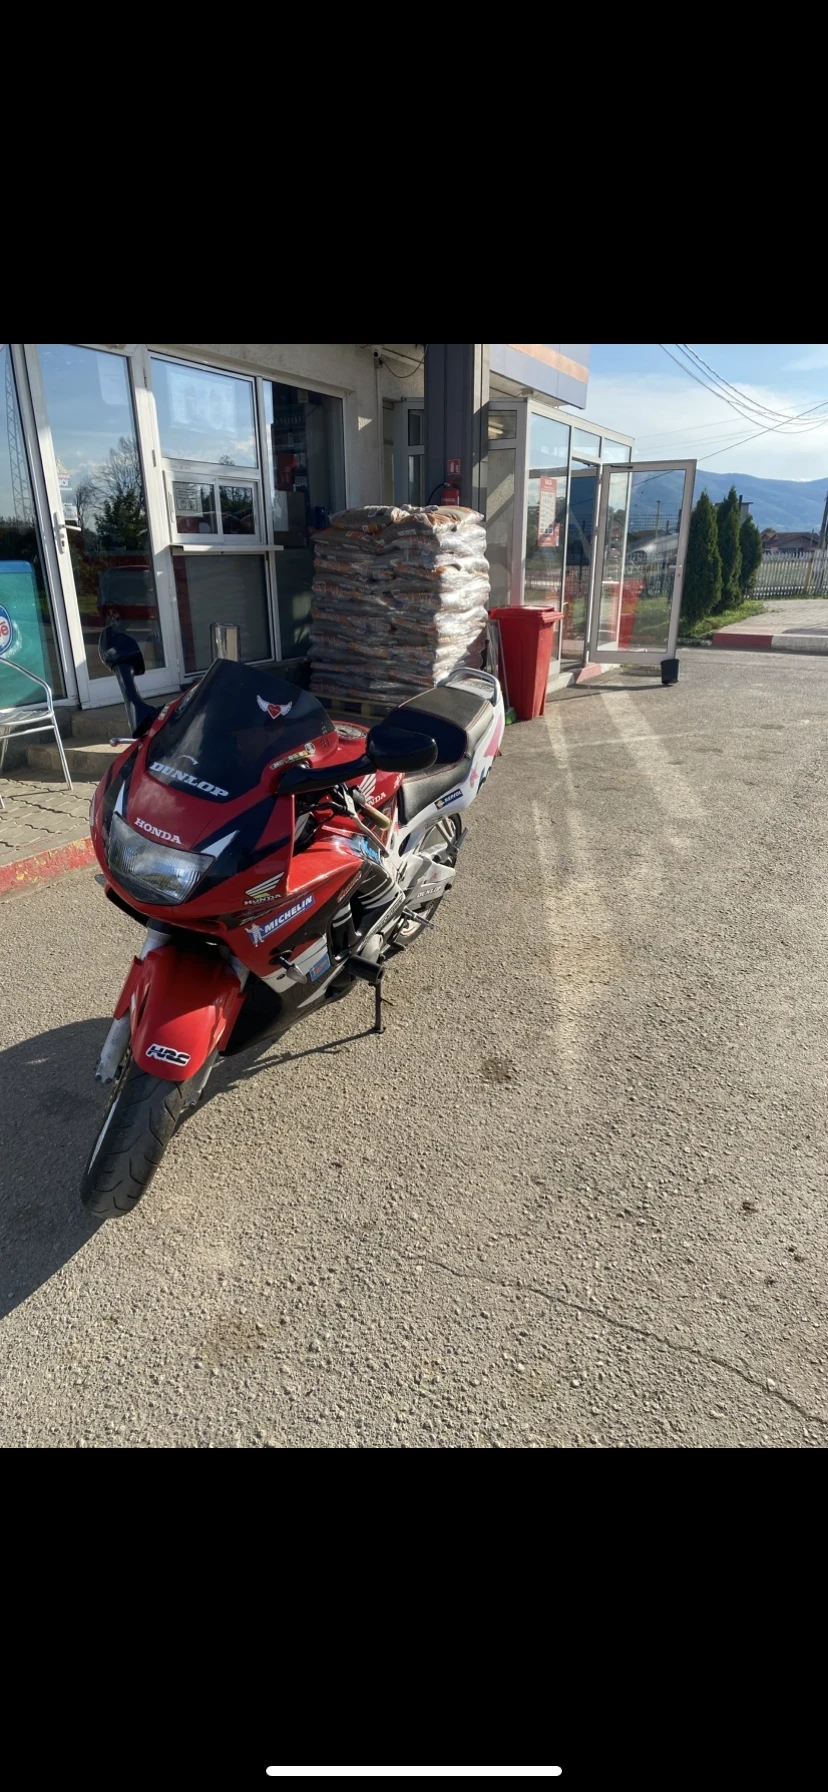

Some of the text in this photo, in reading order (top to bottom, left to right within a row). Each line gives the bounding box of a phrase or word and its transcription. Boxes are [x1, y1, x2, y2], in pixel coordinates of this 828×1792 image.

[149, 762, 229, 797] DUNLOP
[367, 791, 387, 807] NDA
[134, 817, 182, 845] HONDA
[243, 893, 281, 906] HONDA
[264, 895, 313, 933] MICHELIN
[146, 1044, 191, 1066] HRC
